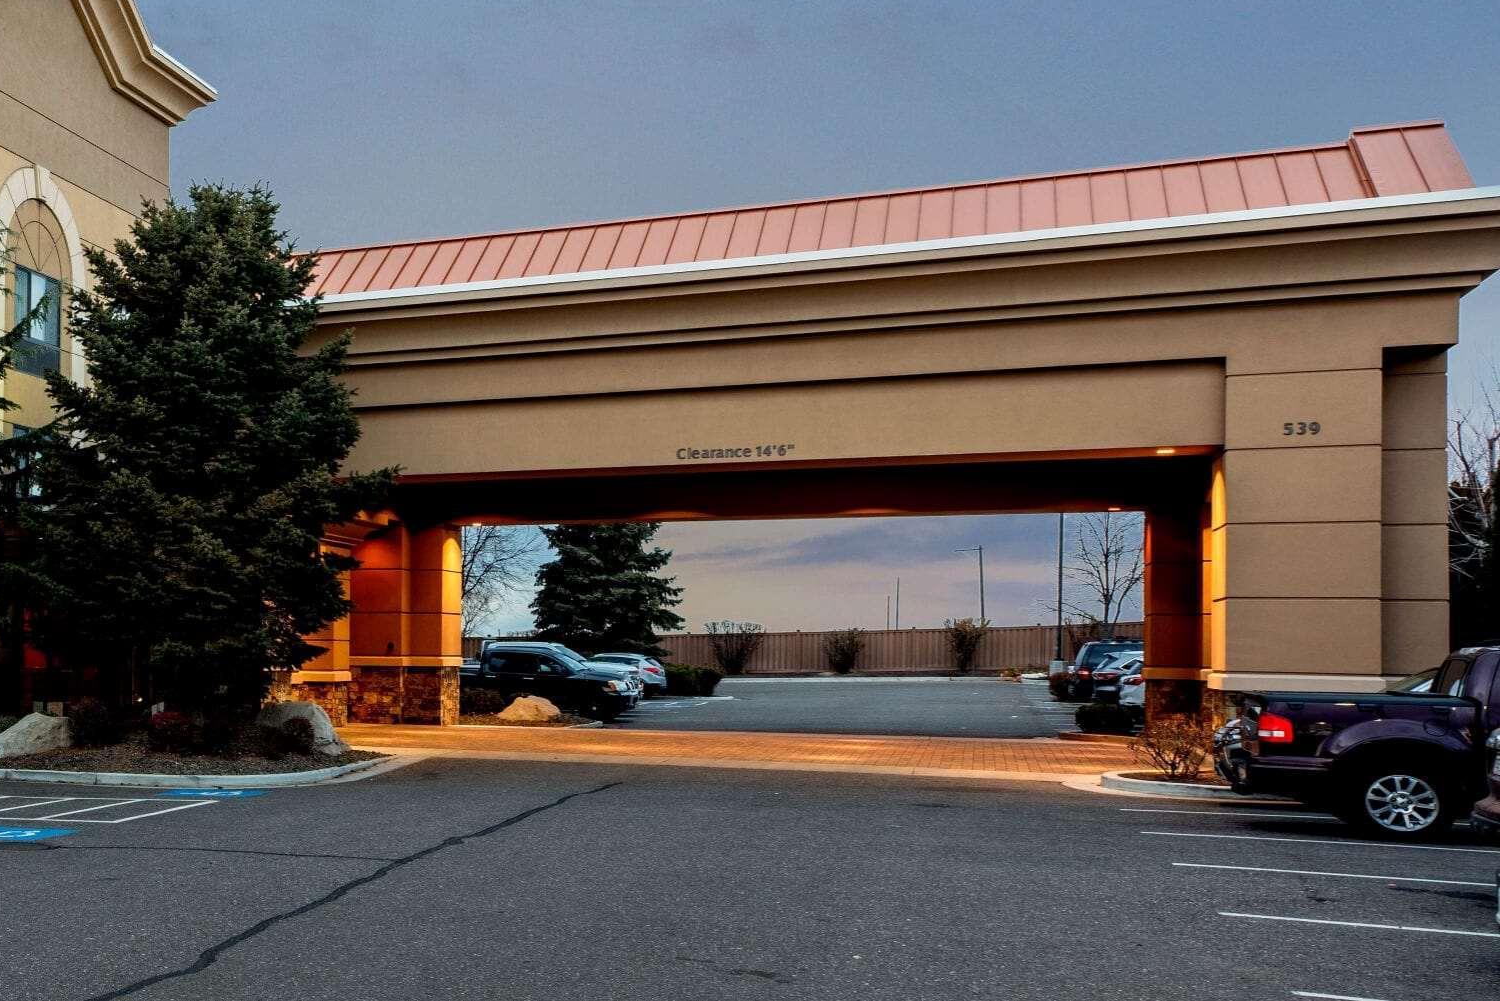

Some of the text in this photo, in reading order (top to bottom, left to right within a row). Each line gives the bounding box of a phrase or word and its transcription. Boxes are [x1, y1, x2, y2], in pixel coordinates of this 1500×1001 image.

[1283, 422, 1321, 436] 539
[676, 444, 795, 460] Clearance 14'6"
